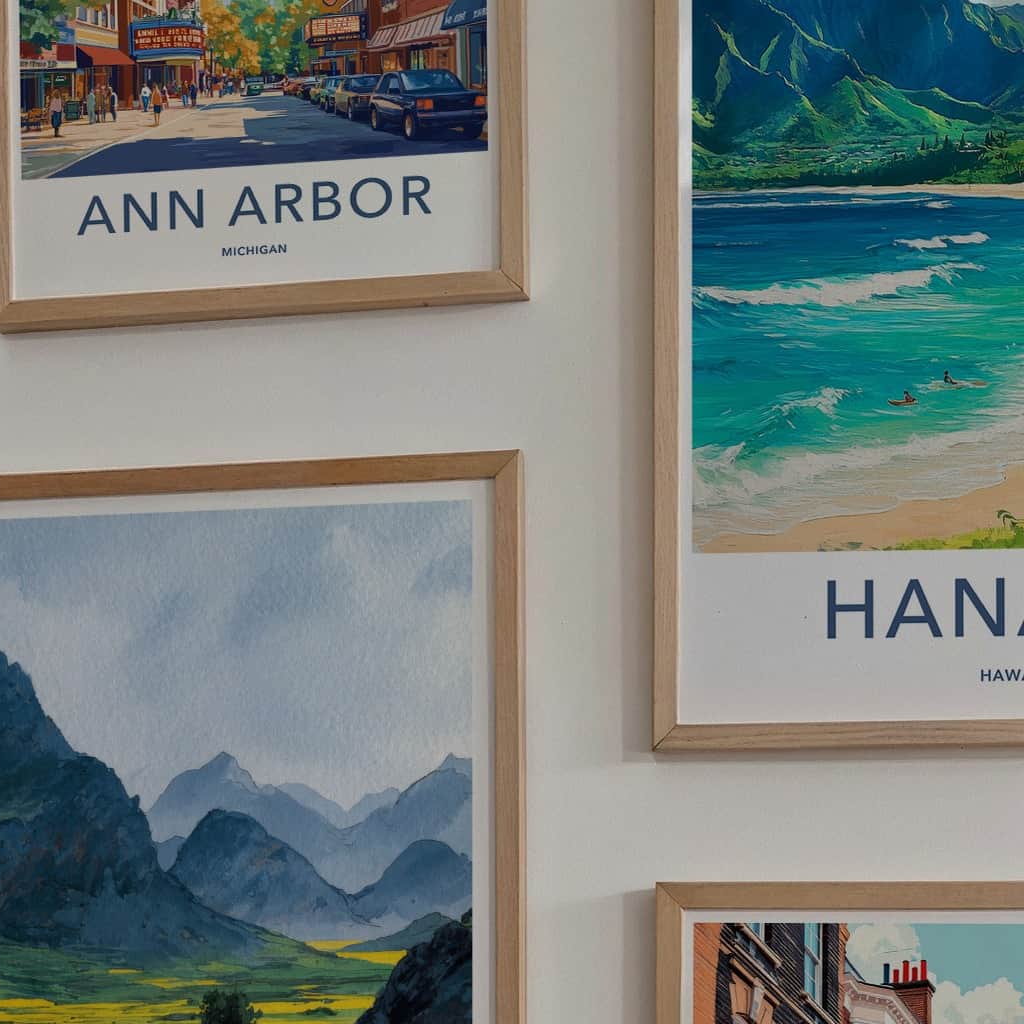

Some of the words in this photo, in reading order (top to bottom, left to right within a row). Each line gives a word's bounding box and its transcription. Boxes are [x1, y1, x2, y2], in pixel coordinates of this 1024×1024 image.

[77, 188, 205, 236] ANN
[228, 175, 433, 226] ARBOR
[221, 243, 288, 257] MICHIGAN
[827, 577, 1024, 640] HAN
[980, 669, 1024, 683] HAW
